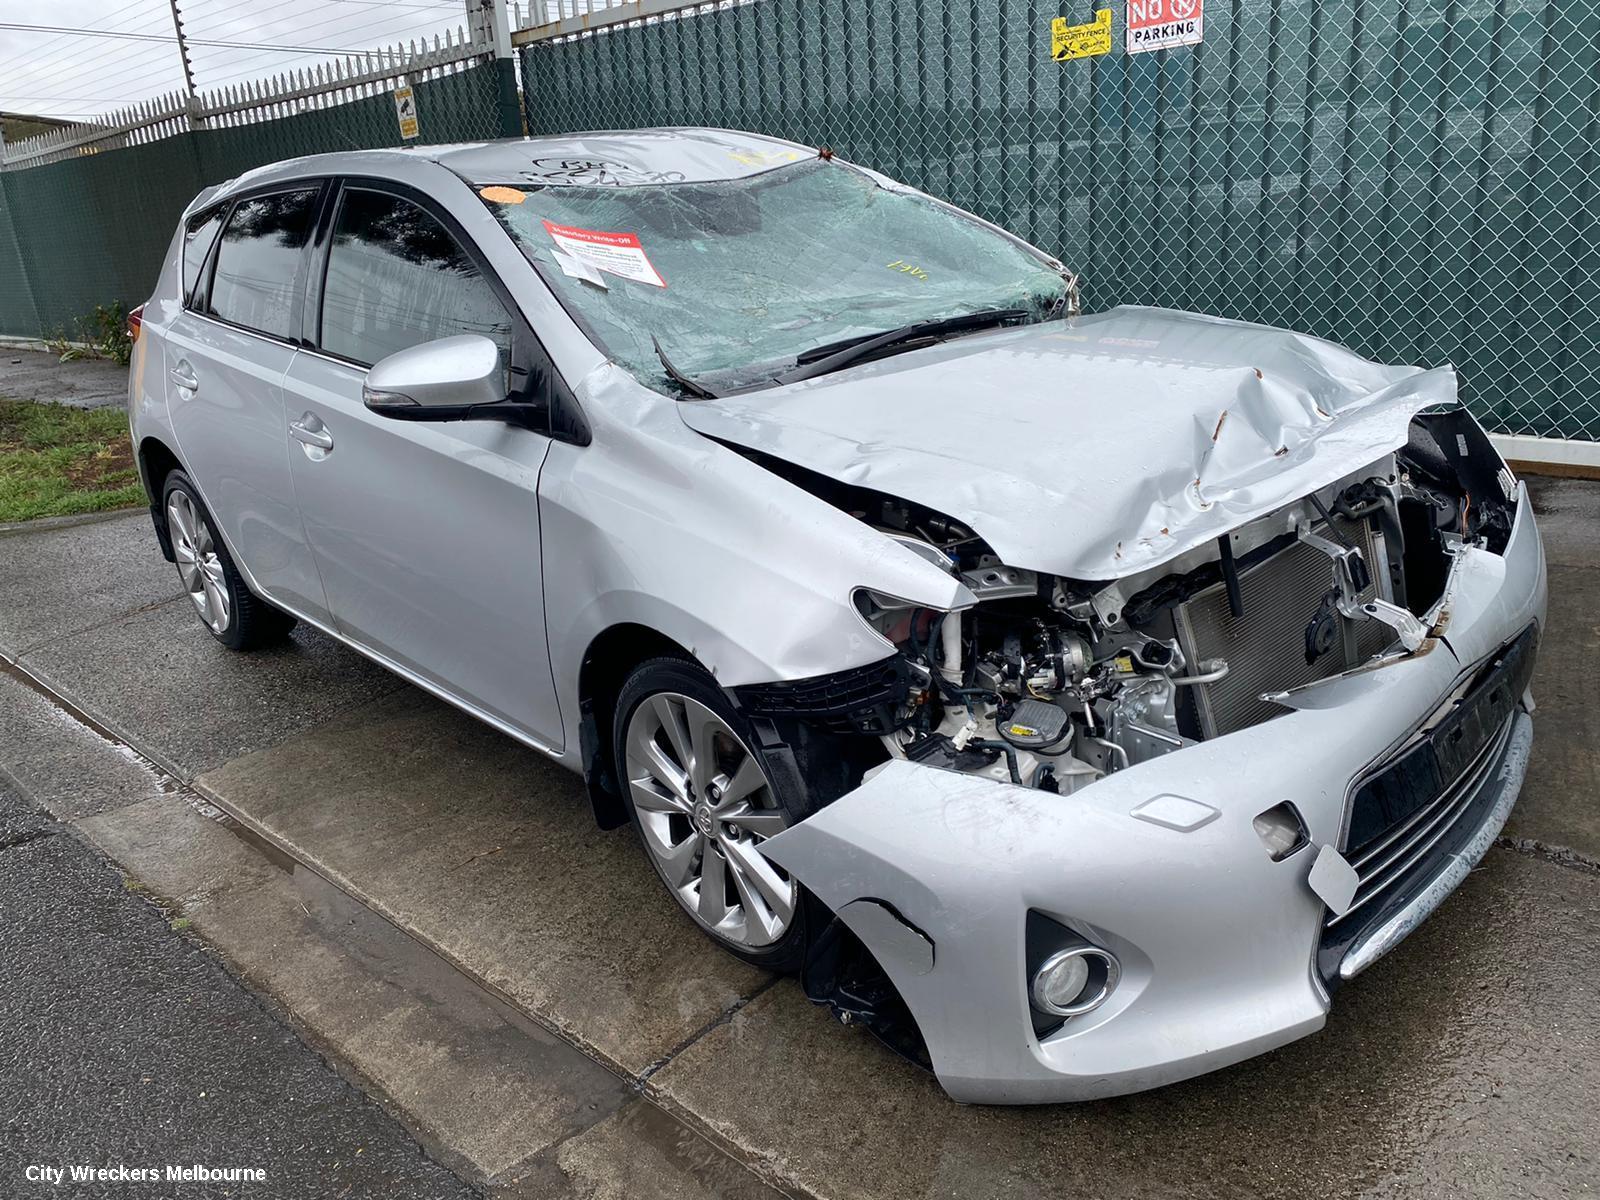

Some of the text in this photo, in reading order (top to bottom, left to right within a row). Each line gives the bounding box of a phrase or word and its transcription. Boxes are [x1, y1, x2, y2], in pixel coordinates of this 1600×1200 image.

[1132, 0, 1162, 23] NO
[1056, 31, 1086, 42] SECURITY
[1086, 28, 1106, 38] FENCE
[1135, 21, 1194, 43] PARKING
